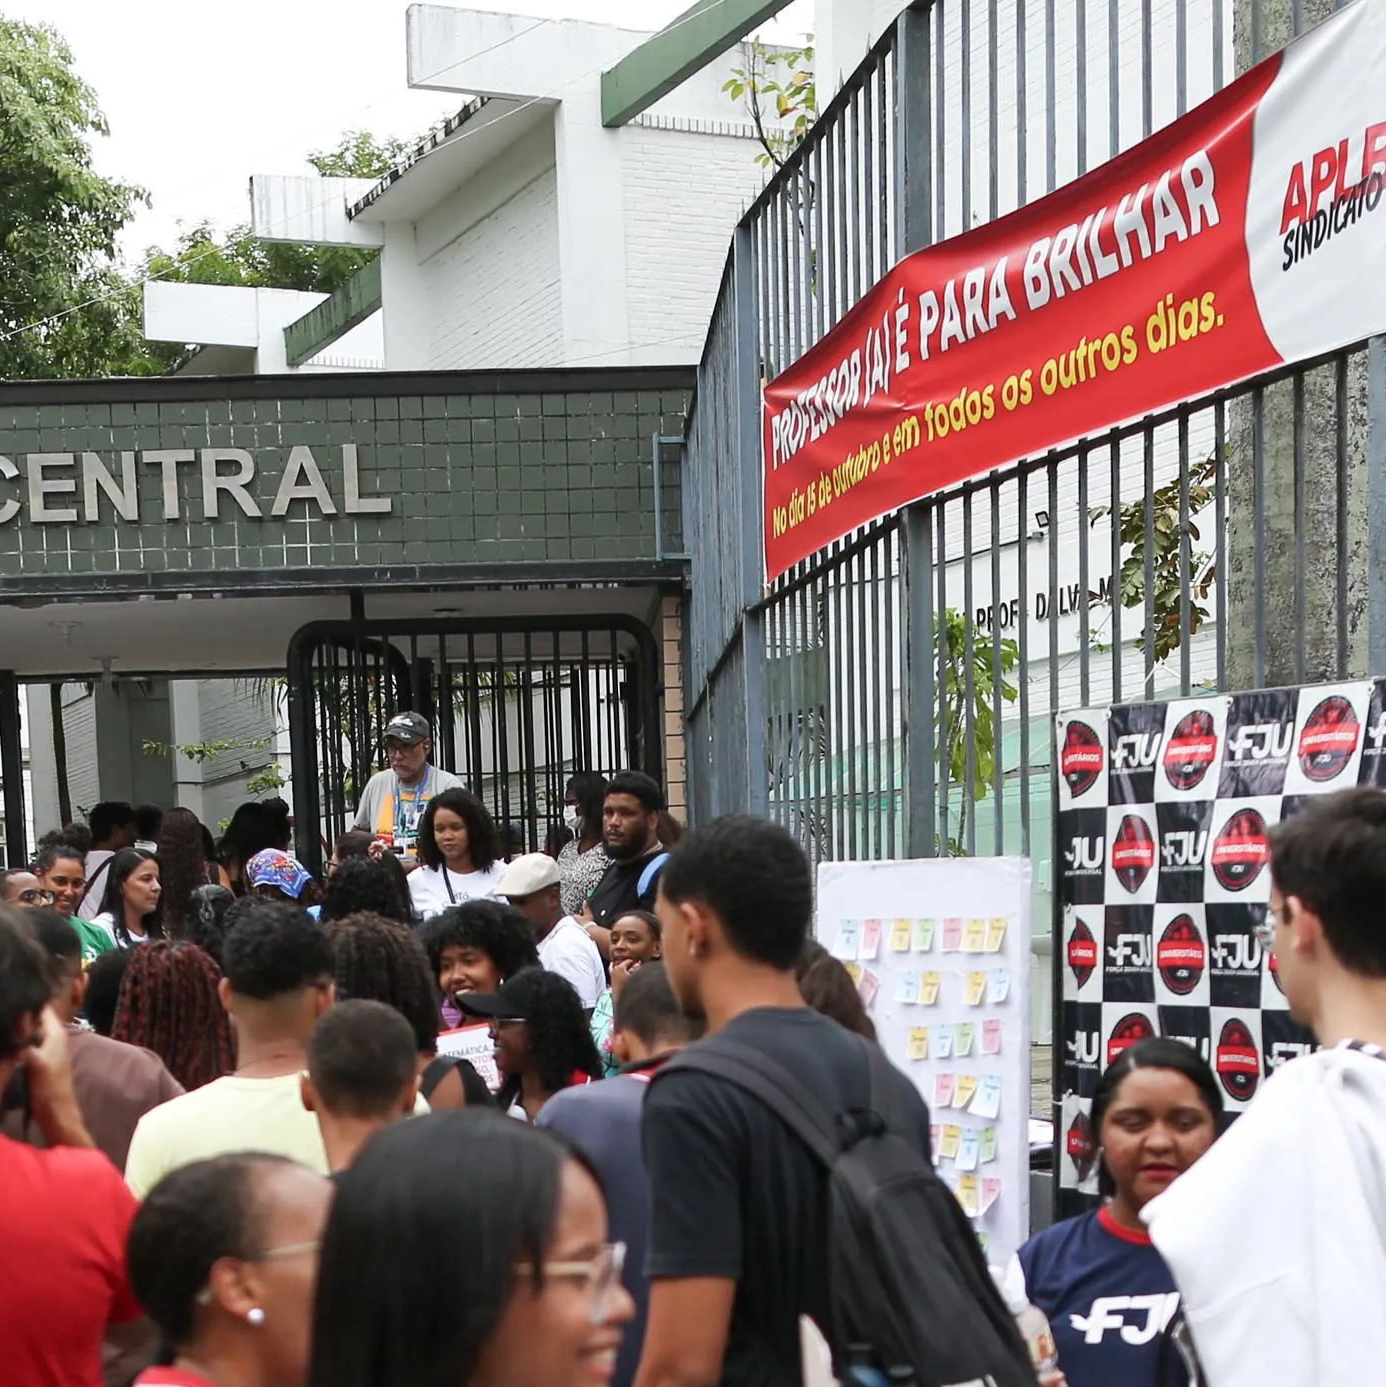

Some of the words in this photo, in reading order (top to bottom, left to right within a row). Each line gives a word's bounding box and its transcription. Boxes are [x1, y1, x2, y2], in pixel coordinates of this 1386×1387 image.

[1282, 171, 1383, 272] SINDICATO
[771, 347, 862, 470] PROFESSOR
[895, 286, 911, 374] É
[918, 256, 1017, 361] PARA
[1023, 148, 1221, 311] BRILHAR
[773, 507, 788, 539] No
[788, 487, 805, 528] dia
[807, 480, 817, 517] 15
[818, 470, 832, 508] de
[832, 440, 881, 496] outubro
[882, 432, 891, 464] e
[893, 415, 921, 457] em
[924, 384, 996, 441] todos
[1001, 367, 1033, 411] os
[1040, 323, 1137, 396] outros
[1146, 291, 1225, 353] dias.
[1232, 722, 1294, 760] FJU
